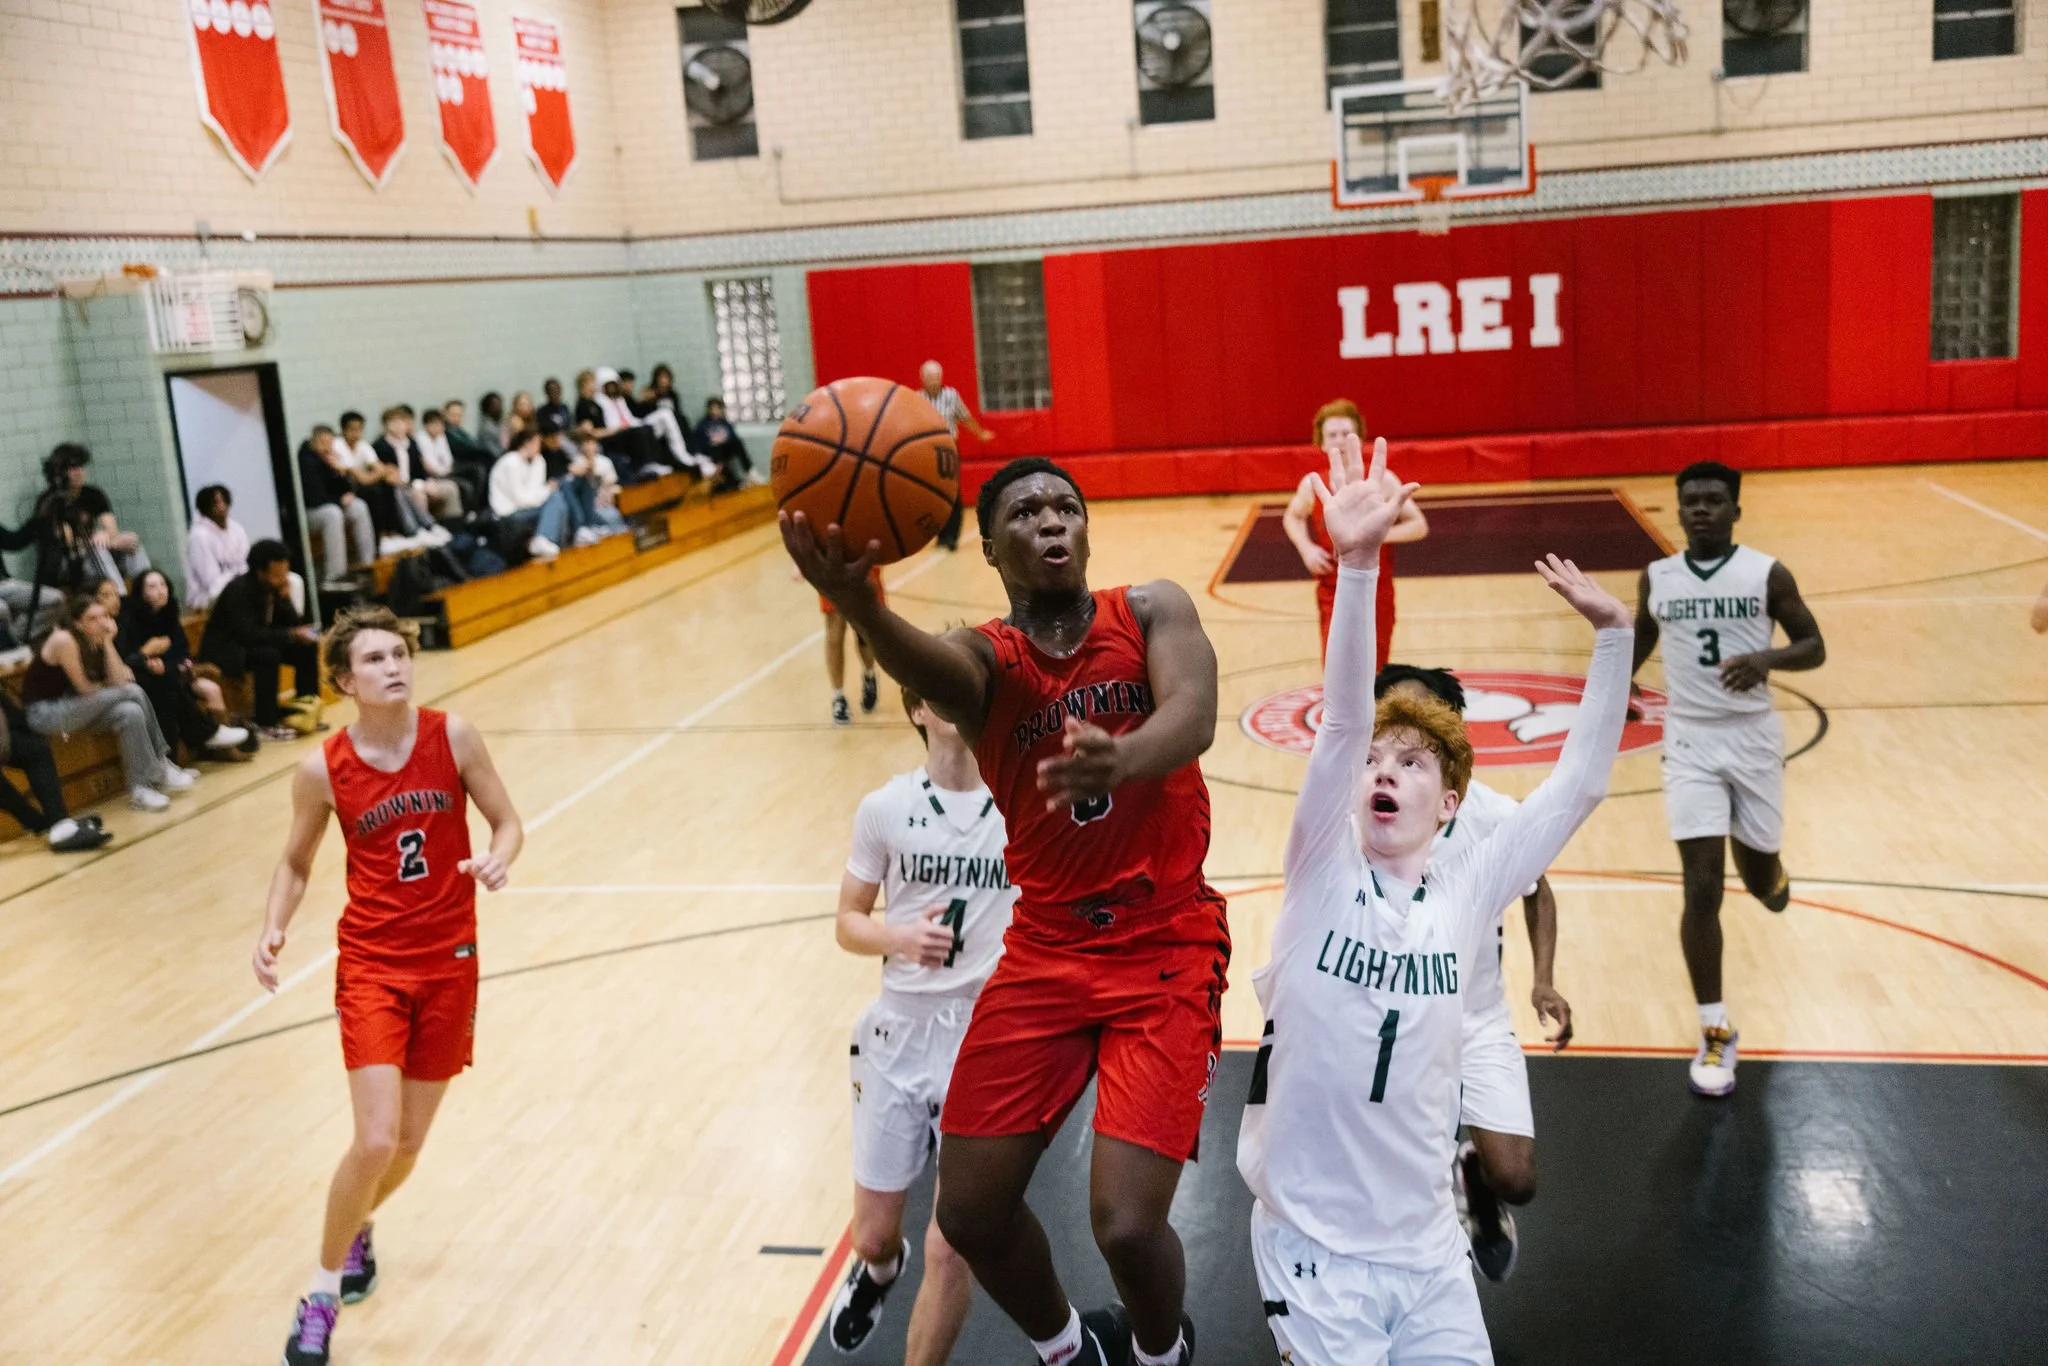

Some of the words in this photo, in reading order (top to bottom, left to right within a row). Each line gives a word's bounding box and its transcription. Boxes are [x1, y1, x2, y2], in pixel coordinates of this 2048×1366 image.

[1657, 596, 1760, 622] LIGHTNING
[1696, 628, 1720, 667] 3
[397, 828, 430, 882] 2
[1316, 930, 1458, 996] LIGHTNING
[1369, 1008, 1400, 1104] 1
